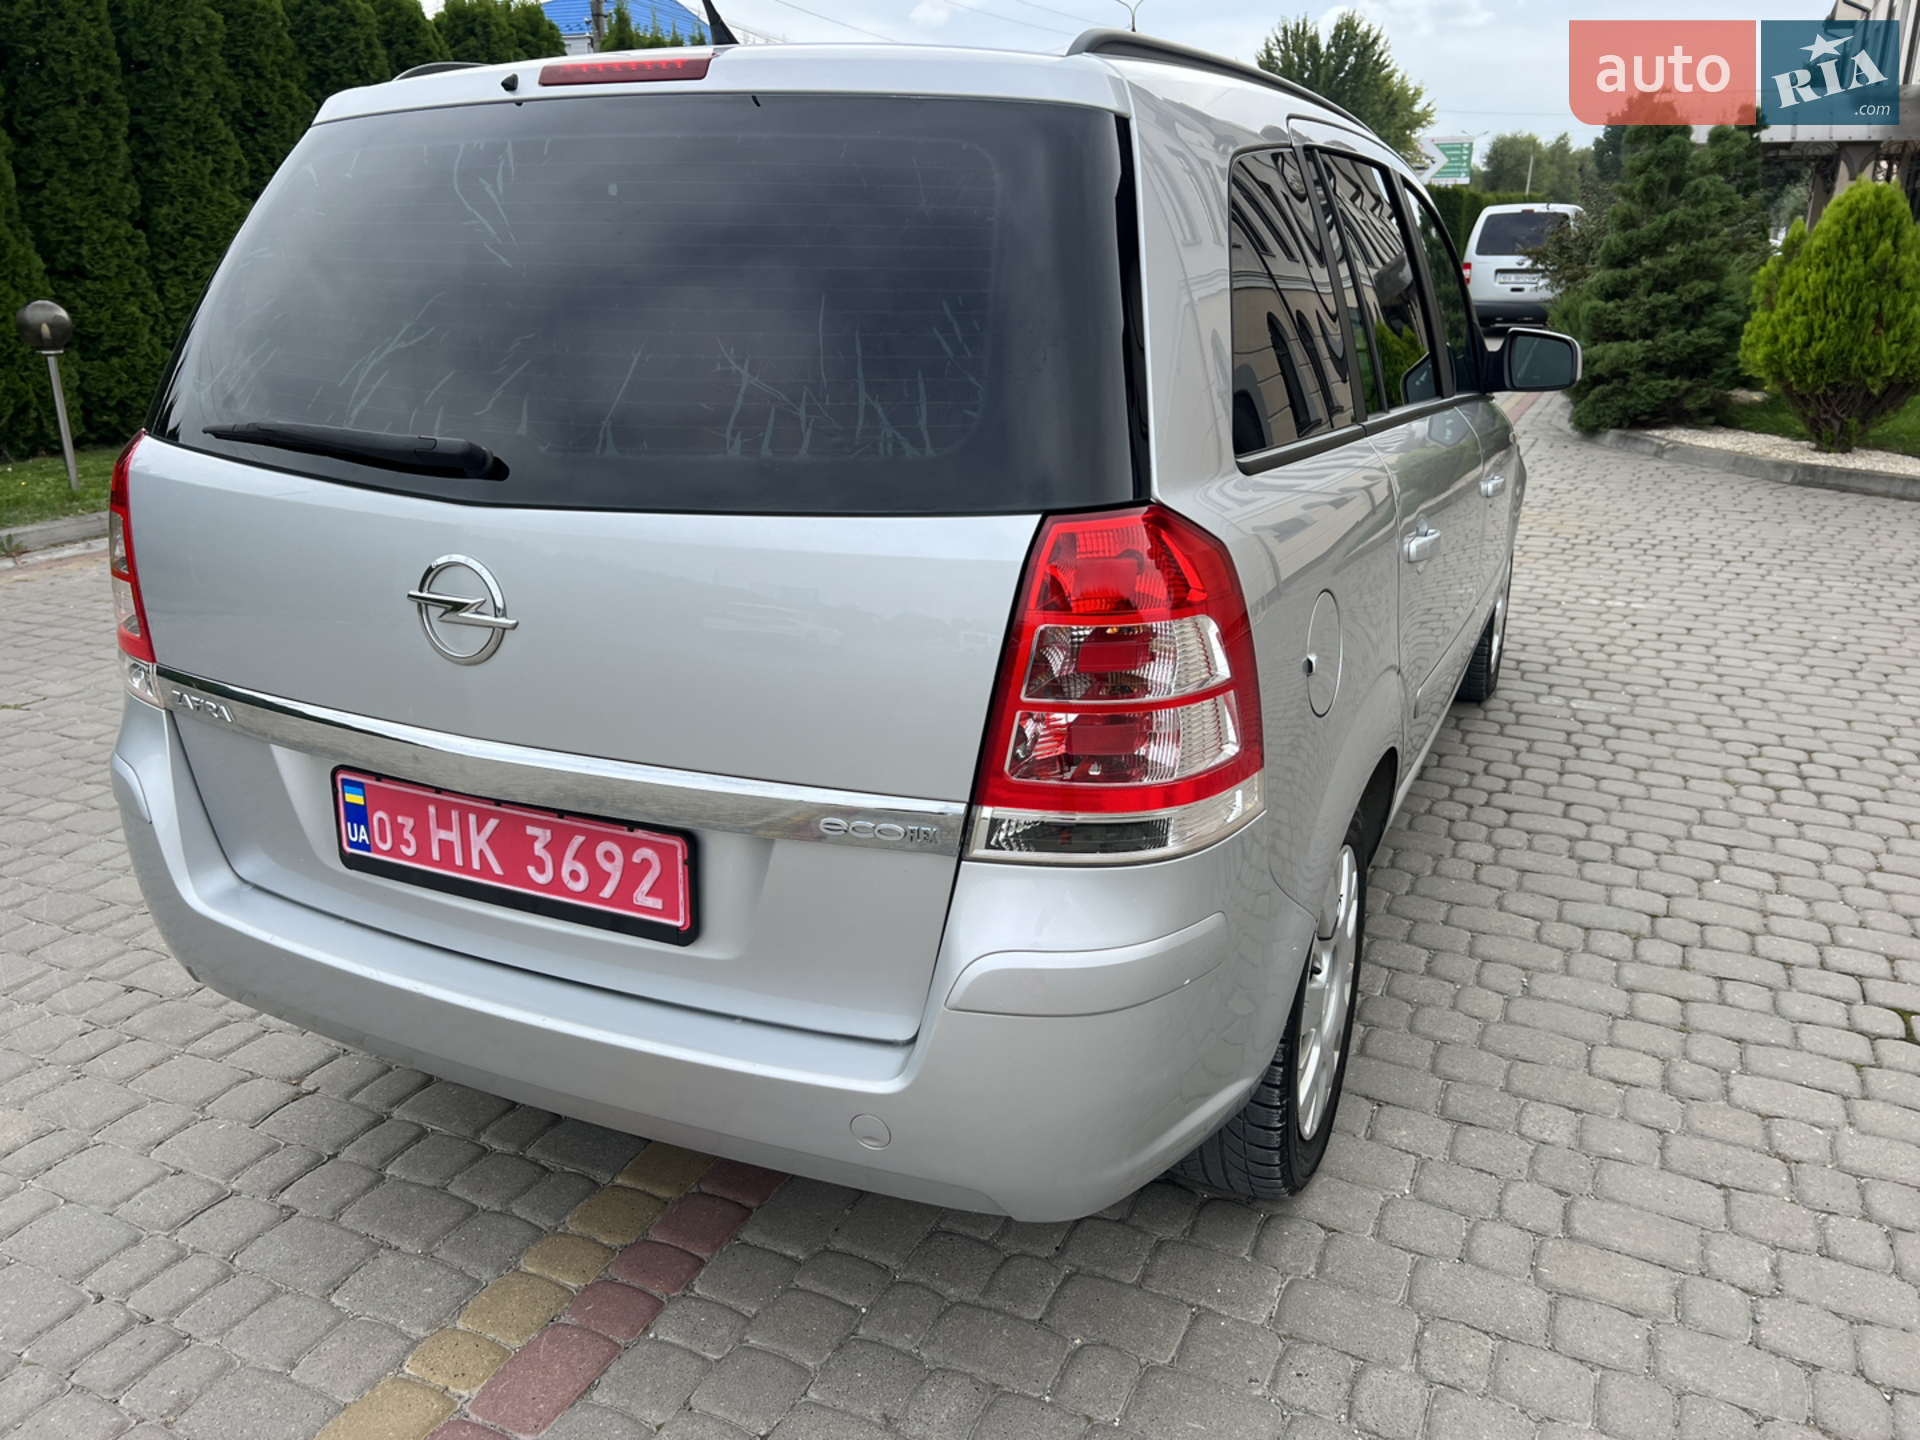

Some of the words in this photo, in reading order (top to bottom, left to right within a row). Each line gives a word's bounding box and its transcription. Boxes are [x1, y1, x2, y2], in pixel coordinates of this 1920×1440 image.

[347, 821, 370, 845] UA
[372, 810, 418, 857] 03
[428, 804, 504, 876] HK
[525, 824, 665, 910] 3692
